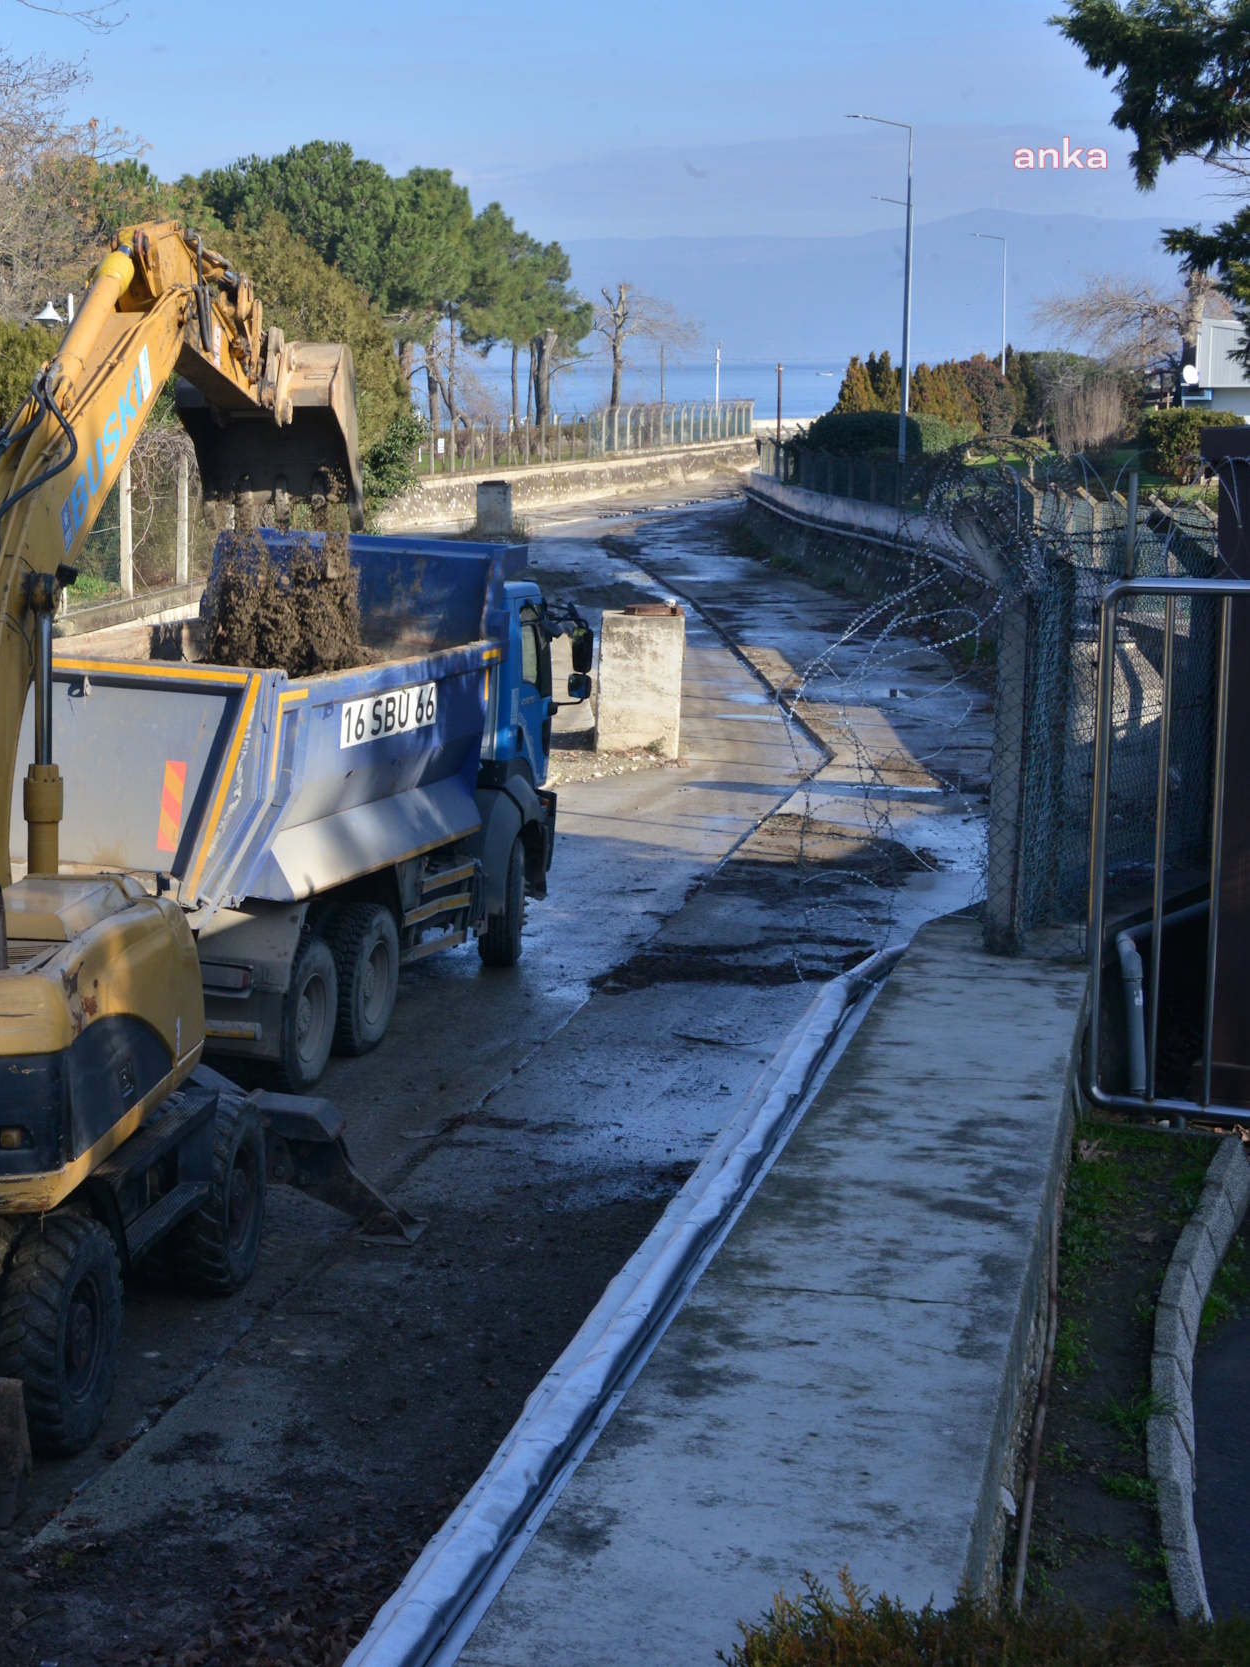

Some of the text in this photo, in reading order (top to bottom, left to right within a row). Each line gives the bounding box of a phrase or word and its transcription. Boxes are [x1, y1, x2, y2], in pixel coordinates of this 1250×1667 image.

[344, 686, 434, 743] 16 SBU 66
